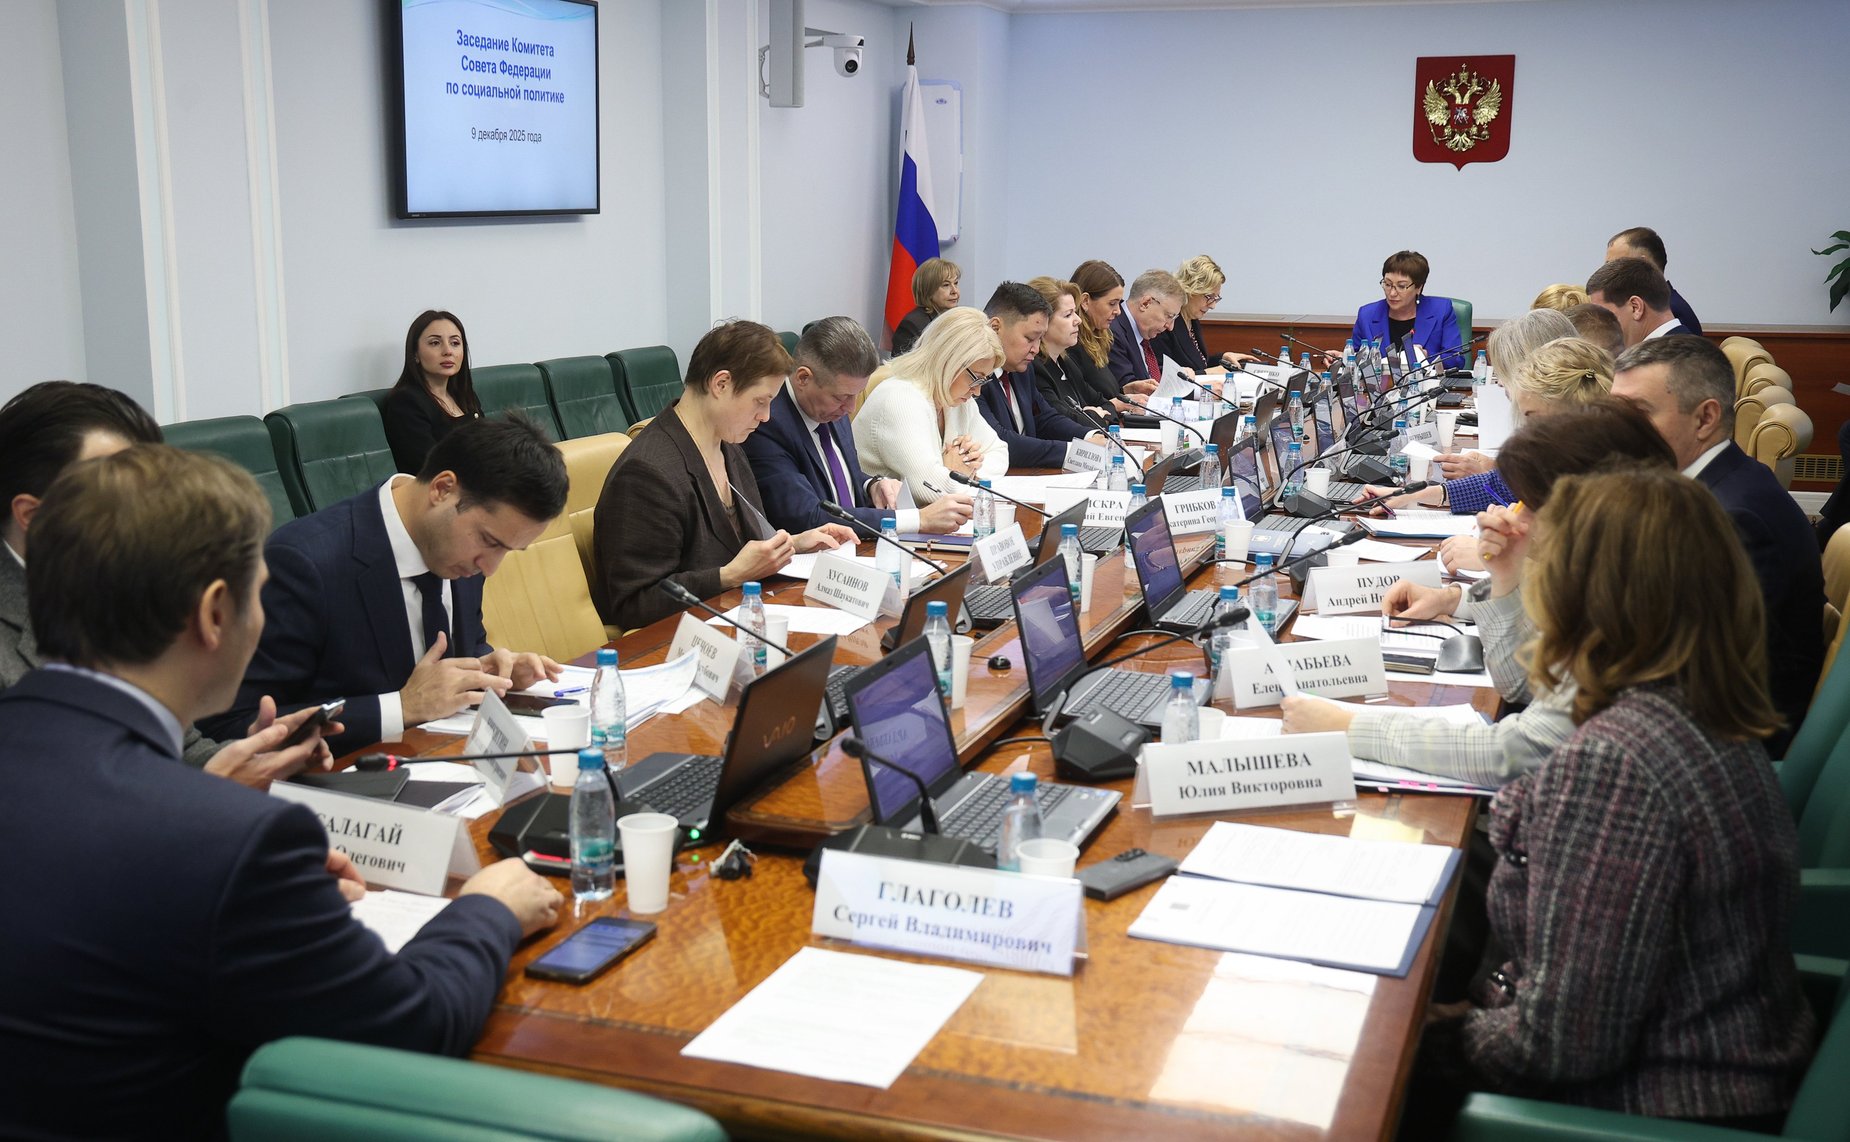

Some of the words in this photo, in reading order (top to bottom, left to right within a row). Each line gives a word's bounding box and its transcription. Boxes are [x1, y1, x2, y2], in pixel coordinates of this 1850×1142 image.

[457, 30, 509, 51] Заседание
[512, 37, 555, 57] Комитета
[461, 55, 497, 74] Совета
[499, 60, 551, 80] Федерации
[446, 82, 459, 95] по
[462, 83, 521, 100] социальной
[523, 88, 565, 104] политике
[471, 127, 477, 140] 9
[478, 128, 508, 143] декабря
[509, 129, 526, 142] 2025
[527, 133, 542, 144] года
[1175, 500, 1217, 514] ГРИБКОВ
[1168, 517, 1201, 529] катерина
[826, 568, 869, 592] ХУСАИНОВ
[1327, 593, 1368, 608] Андрей
[1264, 654, 1352, 675] ААБЬЕВА
[1252, 682, 1281, 695] Елен
[1296, 674, 1368, 690] Анатольевна
[1187, 752, 1312, 776] МАЛЫШЕВА
[1178, 785, 1226, 799] Юлия
[1231, 778, 1323, 795] Викторовна
[877, 880, 1015, 919] ГЛАГОЛЕВ
[833, 904, 899, 929] Сергей
[905, 916, 1053, 955] Владимирович
